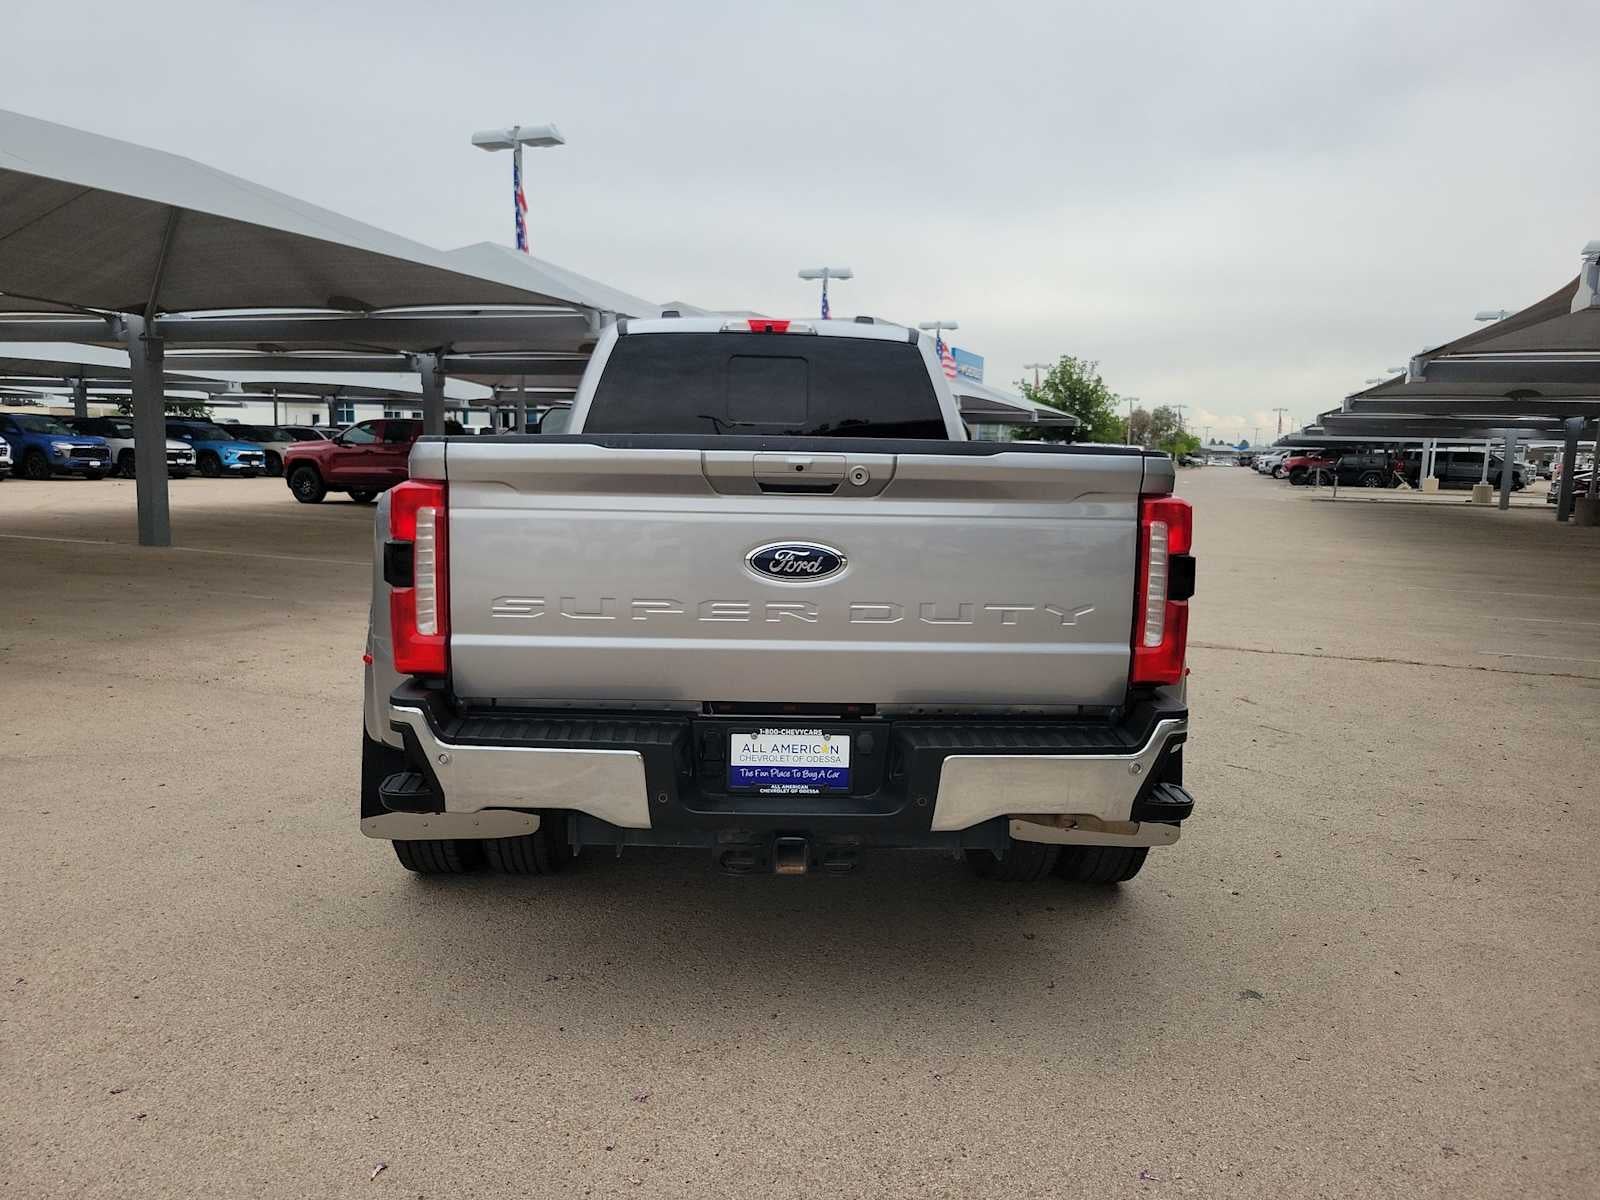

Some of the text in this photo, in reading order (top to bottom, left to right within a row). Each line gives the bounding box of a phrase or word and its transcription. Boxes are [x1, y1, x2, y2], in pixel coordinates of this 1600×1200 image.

[769, 549, 823, 573] Ford
[491, 595, 1096, 628] SUPER DUTY
[742, 743, 766, 753] ALL
[739, 754, 841, 763] CHEVROLET OF ODESSA
[740, 768, 754, 777] The
[770, 768, 790, 778] Place
[791, 768, 801, 778] To
[818, 769, 826, 778] A
[826, 770, 841, 779] Car
